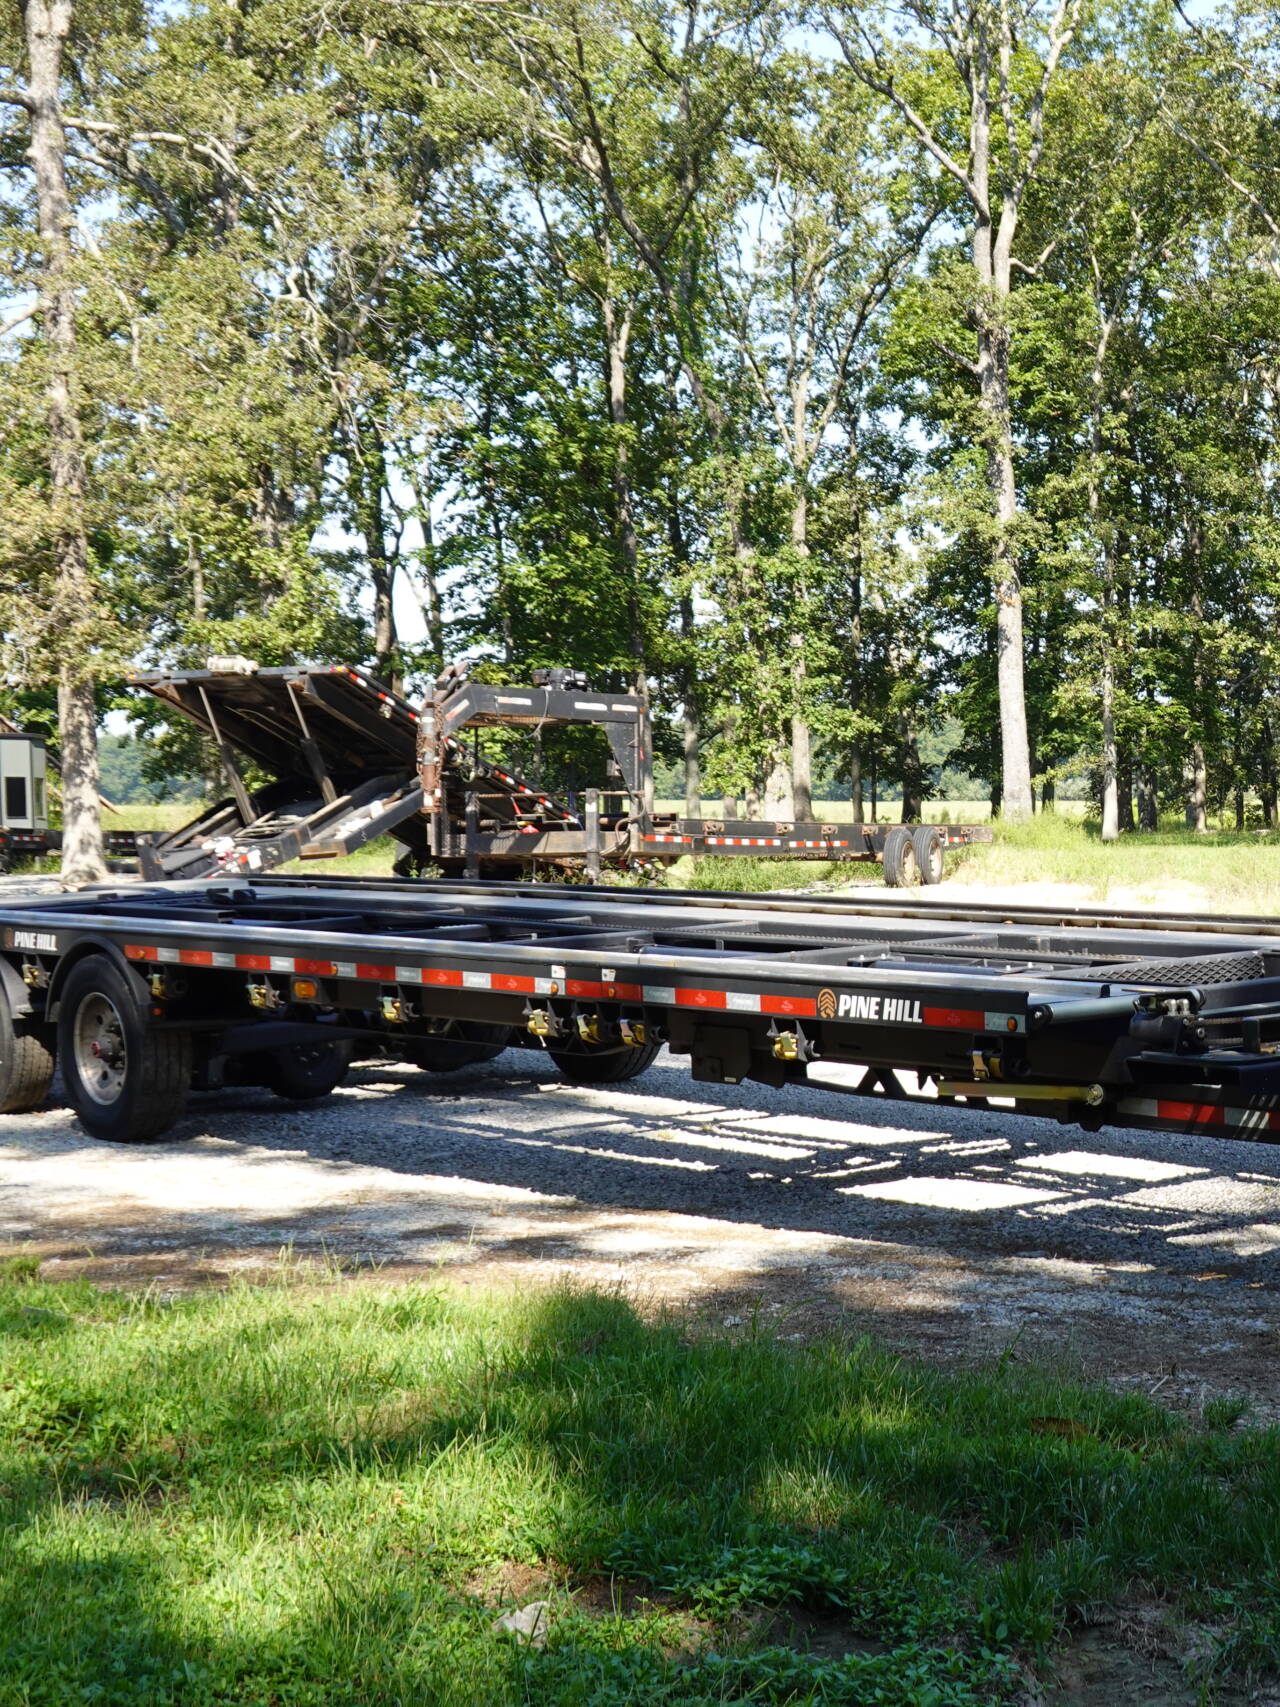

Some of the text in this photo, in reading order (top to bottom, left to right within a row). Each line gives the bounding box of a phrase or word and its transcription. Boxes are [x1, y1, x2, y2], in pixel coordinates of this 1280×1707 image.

[14, 931, 58, 951] PINE HILL
[838, 994, 923, 1023] PINE HILL
